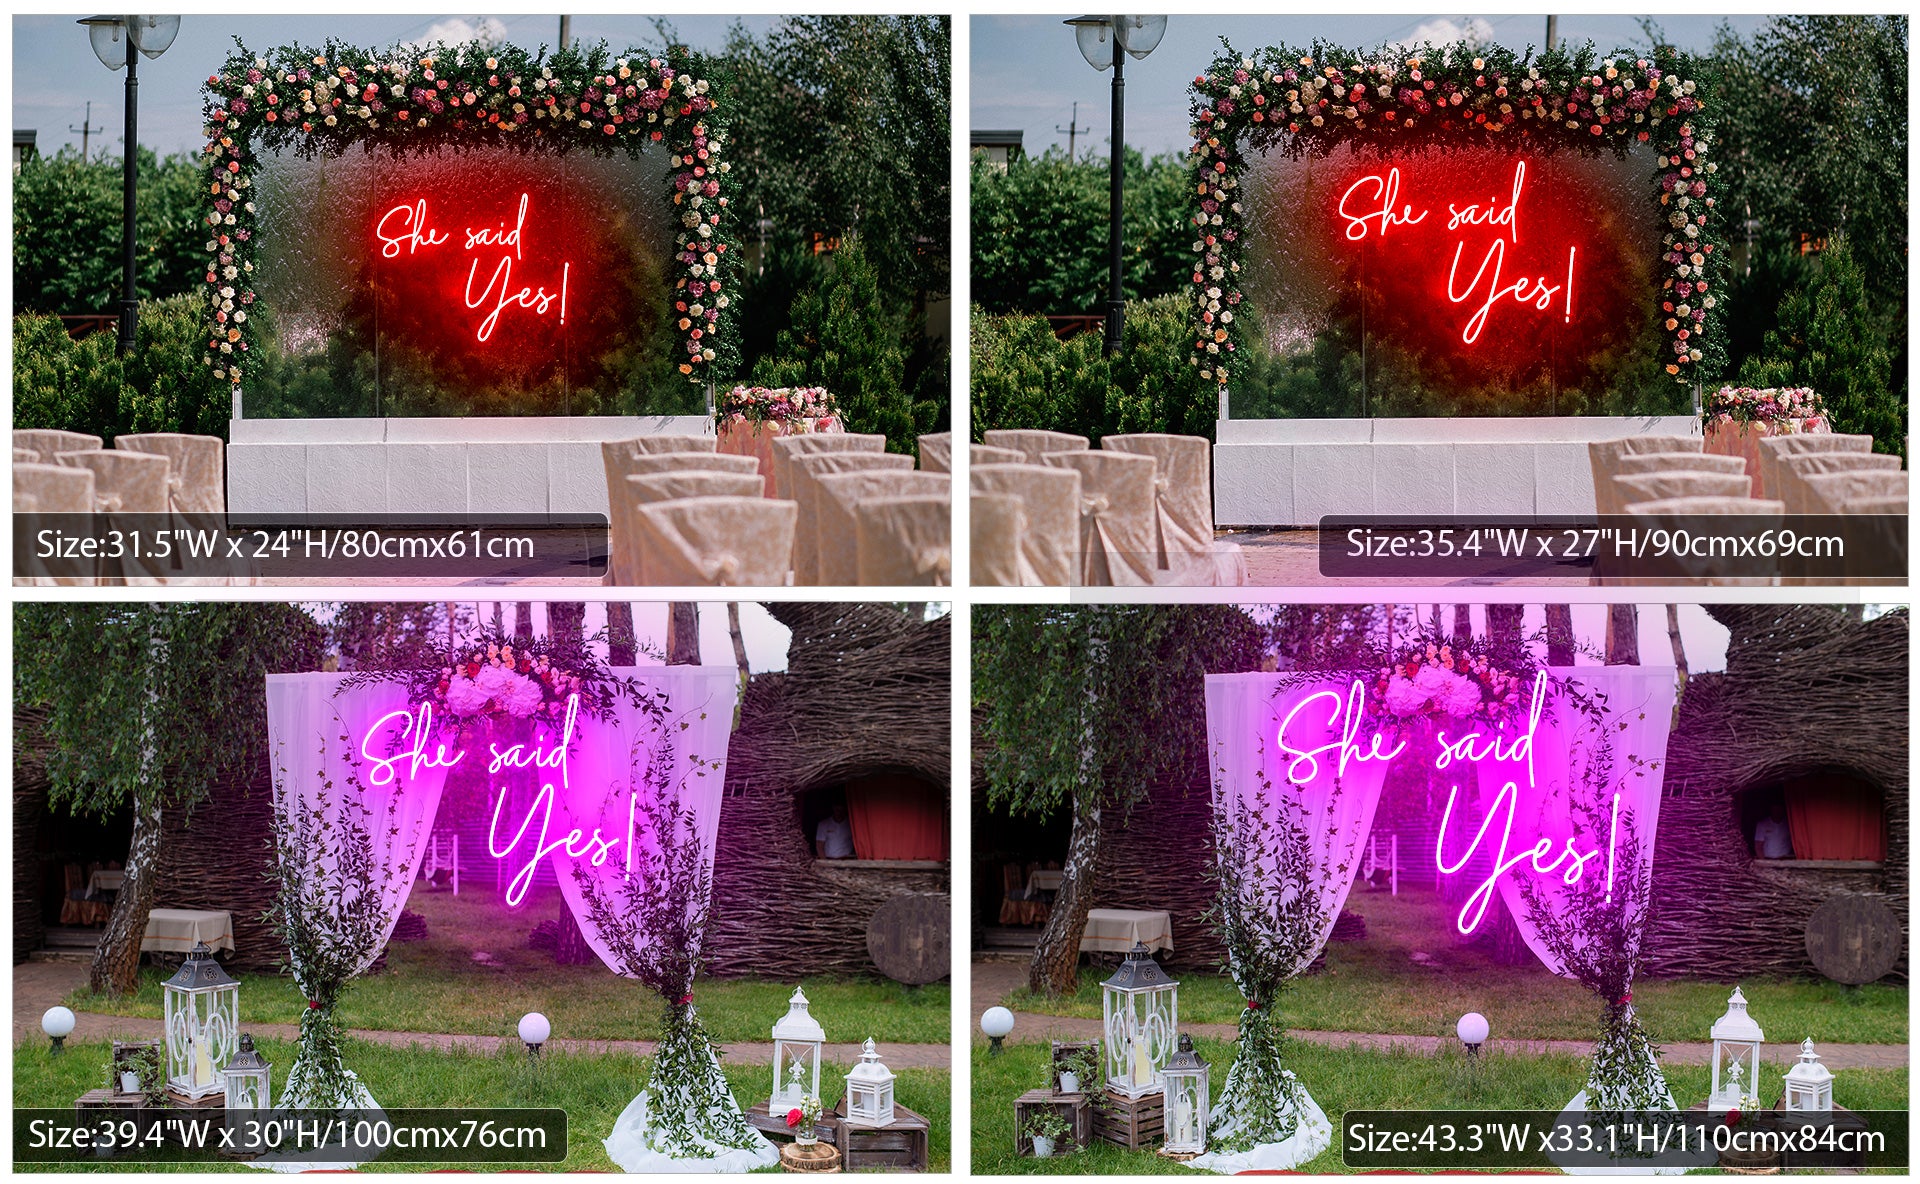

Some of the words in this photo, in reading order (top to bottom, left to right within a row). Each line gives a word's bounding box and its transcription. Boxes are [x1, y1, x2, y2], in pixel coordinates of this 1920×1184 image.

[376, 198, 450, 259] She
[464, 192, 529, 261] said
[1338, 167, 1428, 241] She
[1447, 160, 1526, 244] said
[465, 255, 570, 342] Yes!
[1447, 238, 1577, 345] Yes!
[361, 700, 466, 786] She
[488, 693, 579, 789] said
[1277, 679, 1407, 784] She
[1435, 669, 1547, 788] said
[488, 783, 638, 907] Yes!
[1435, 781, 1621, 935] Yes!
